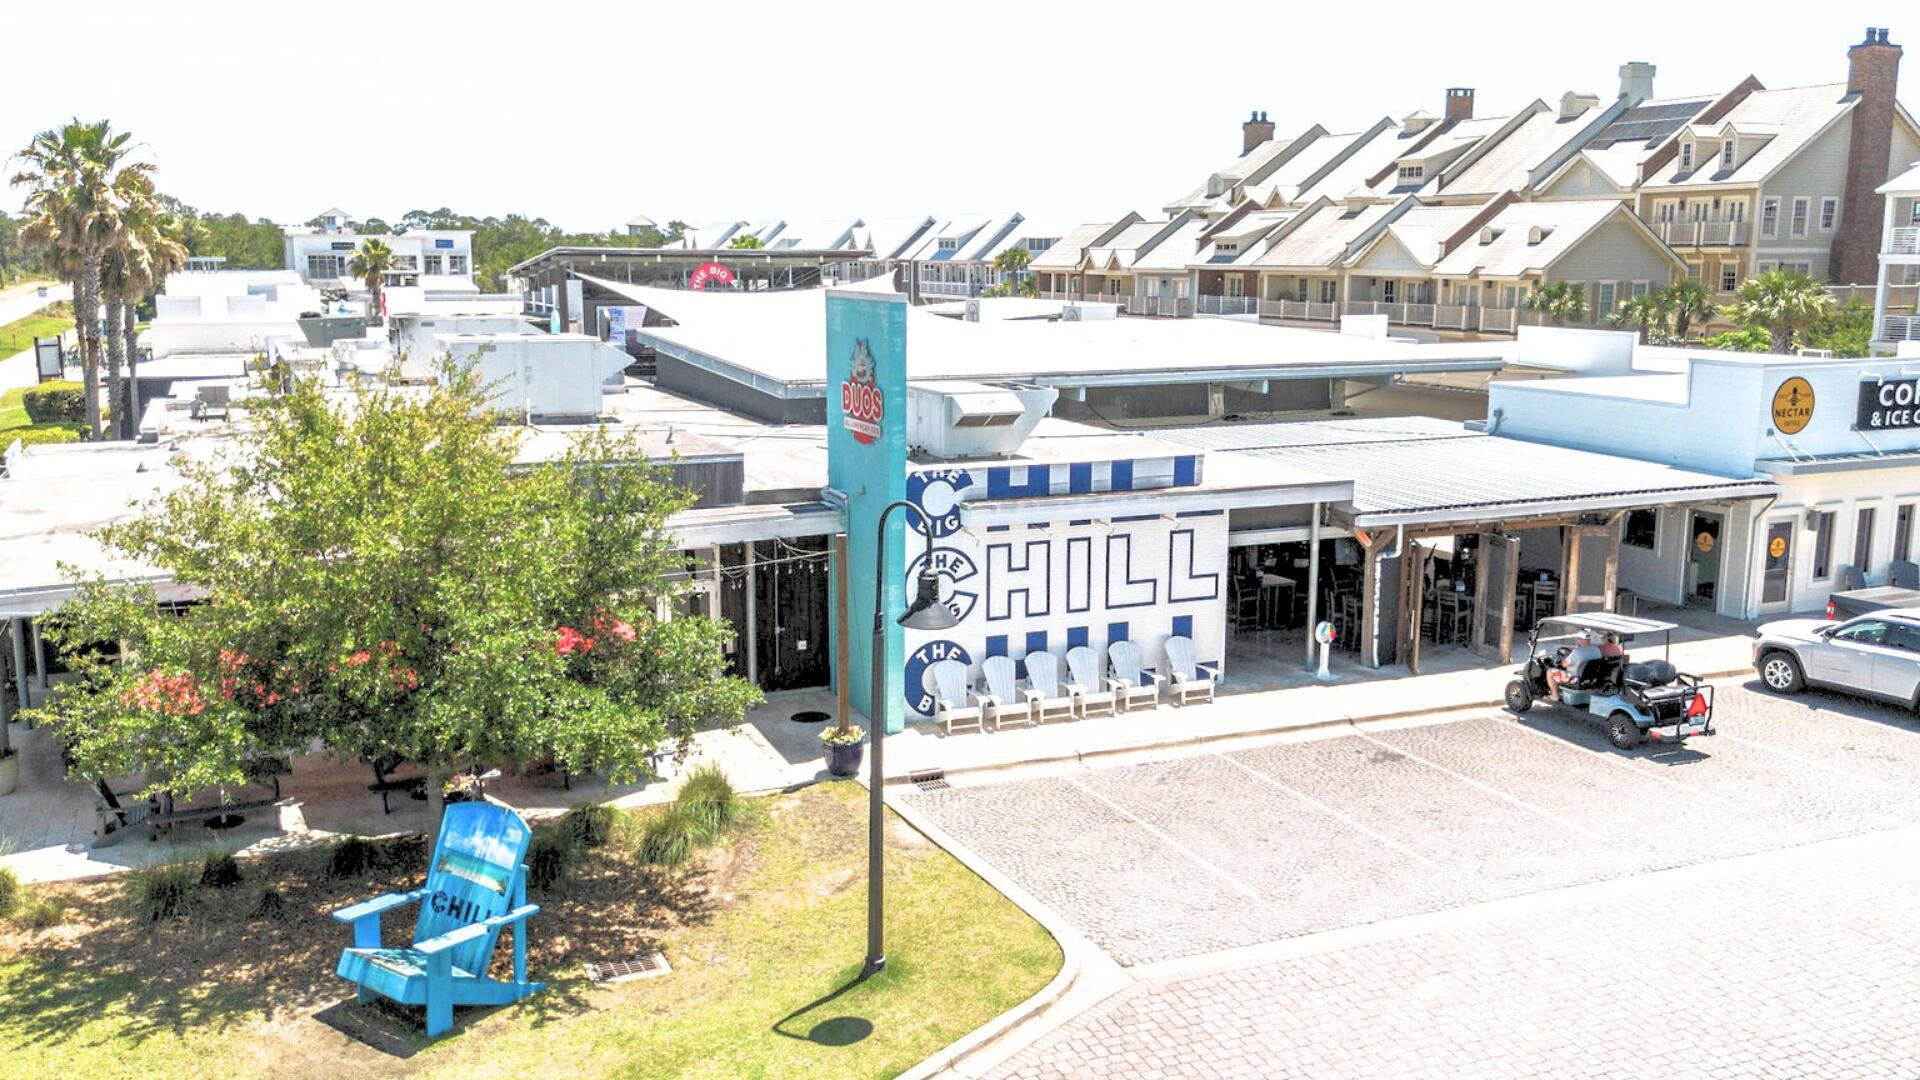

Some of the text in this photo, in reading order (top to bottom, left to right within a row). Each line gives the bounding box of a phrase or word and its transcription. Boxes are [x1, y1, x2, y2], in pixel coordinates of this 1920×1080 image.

[694, 269, 708, 289] THE
[842, 381, 884, 421] DUOS
[1775, 407, 1810, 418] NECTAR
[1871, 411, 1881, 426] &
[1885, 410, 1910, 426] ICE
[914, 469, 963, 484] THE
[905, 529, 1219, 628] CHILL
[916, 643, 961, 666] THE
